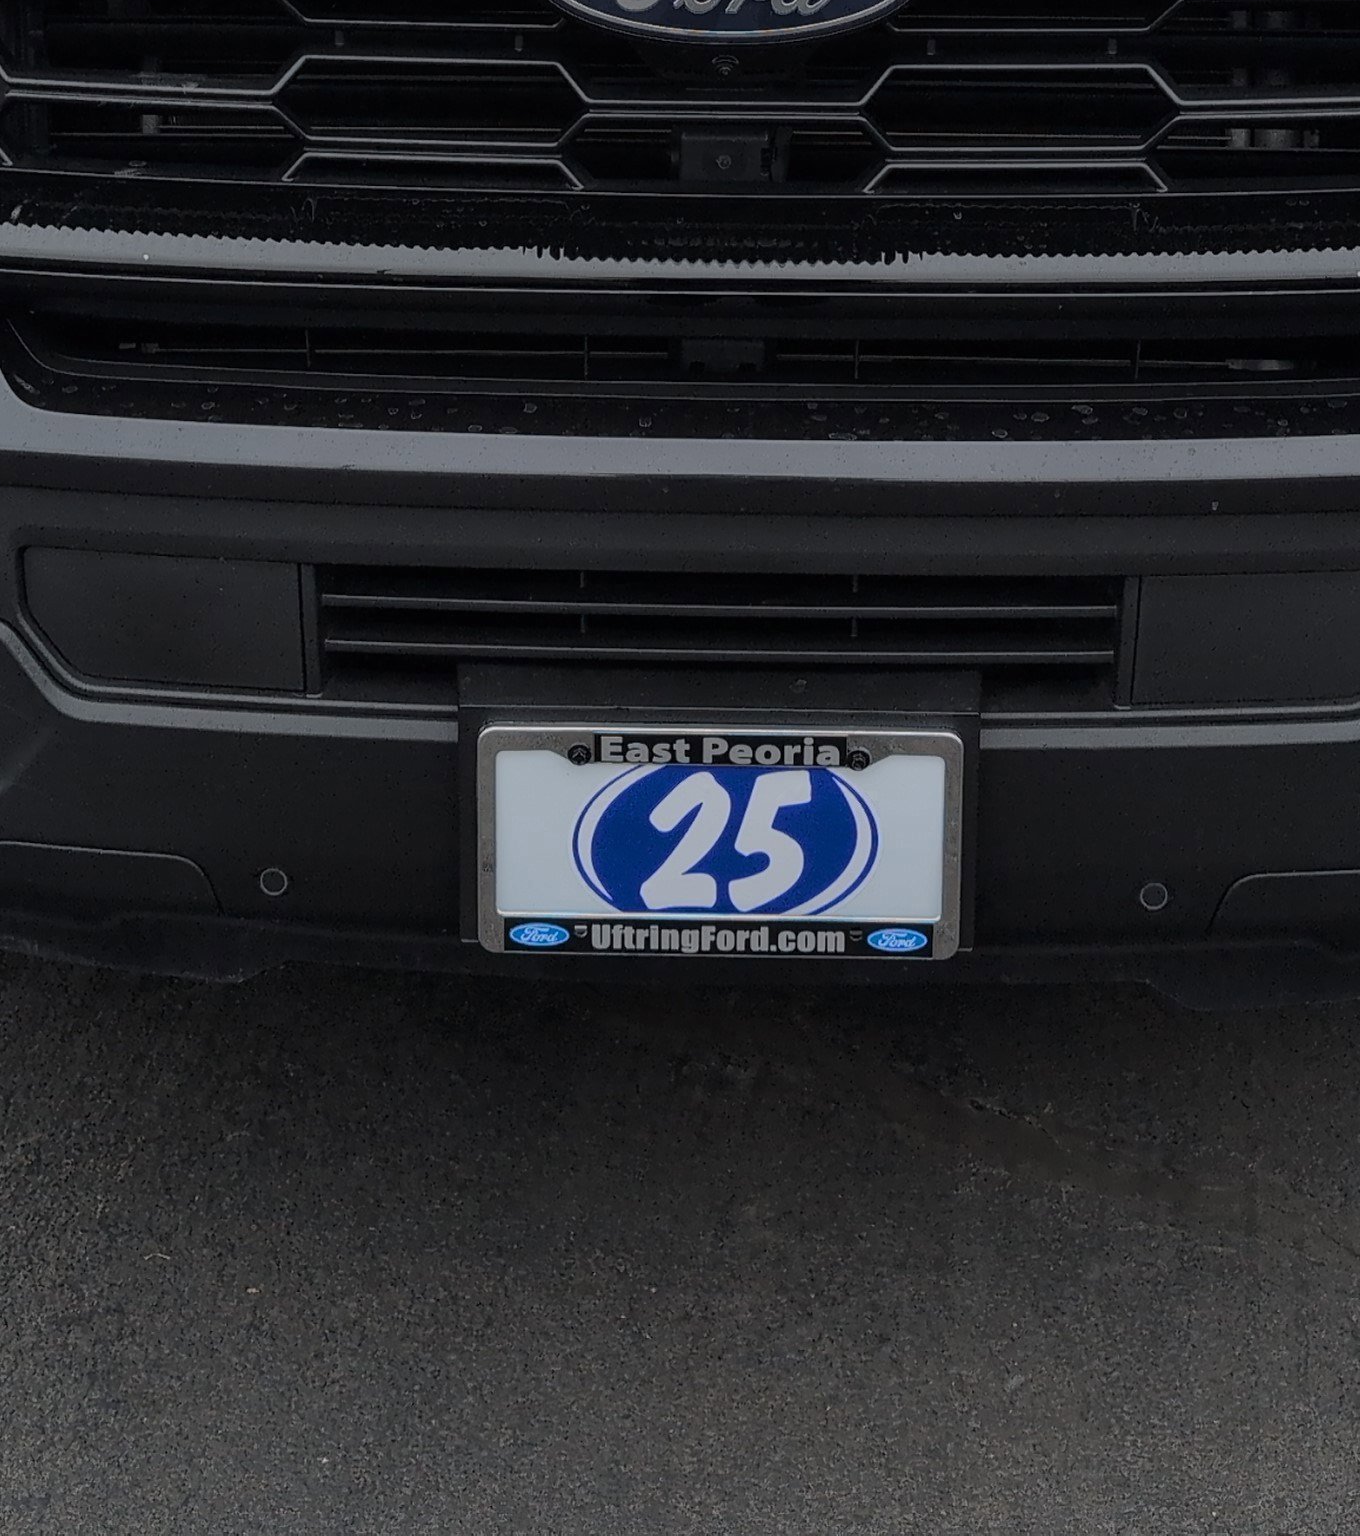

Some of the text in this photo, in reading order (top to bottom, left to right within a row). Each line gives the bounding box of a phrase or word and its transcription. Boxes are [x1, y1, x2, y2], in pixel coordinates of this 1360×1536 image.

[600, 736, 841, 766] East Peoria
[640, 771, 812, 911] 25
[519, 926, 558, 943] Ford
[591, 924, 845, 953] UftringFord.com
[876, 932, 916, 949] Ford
